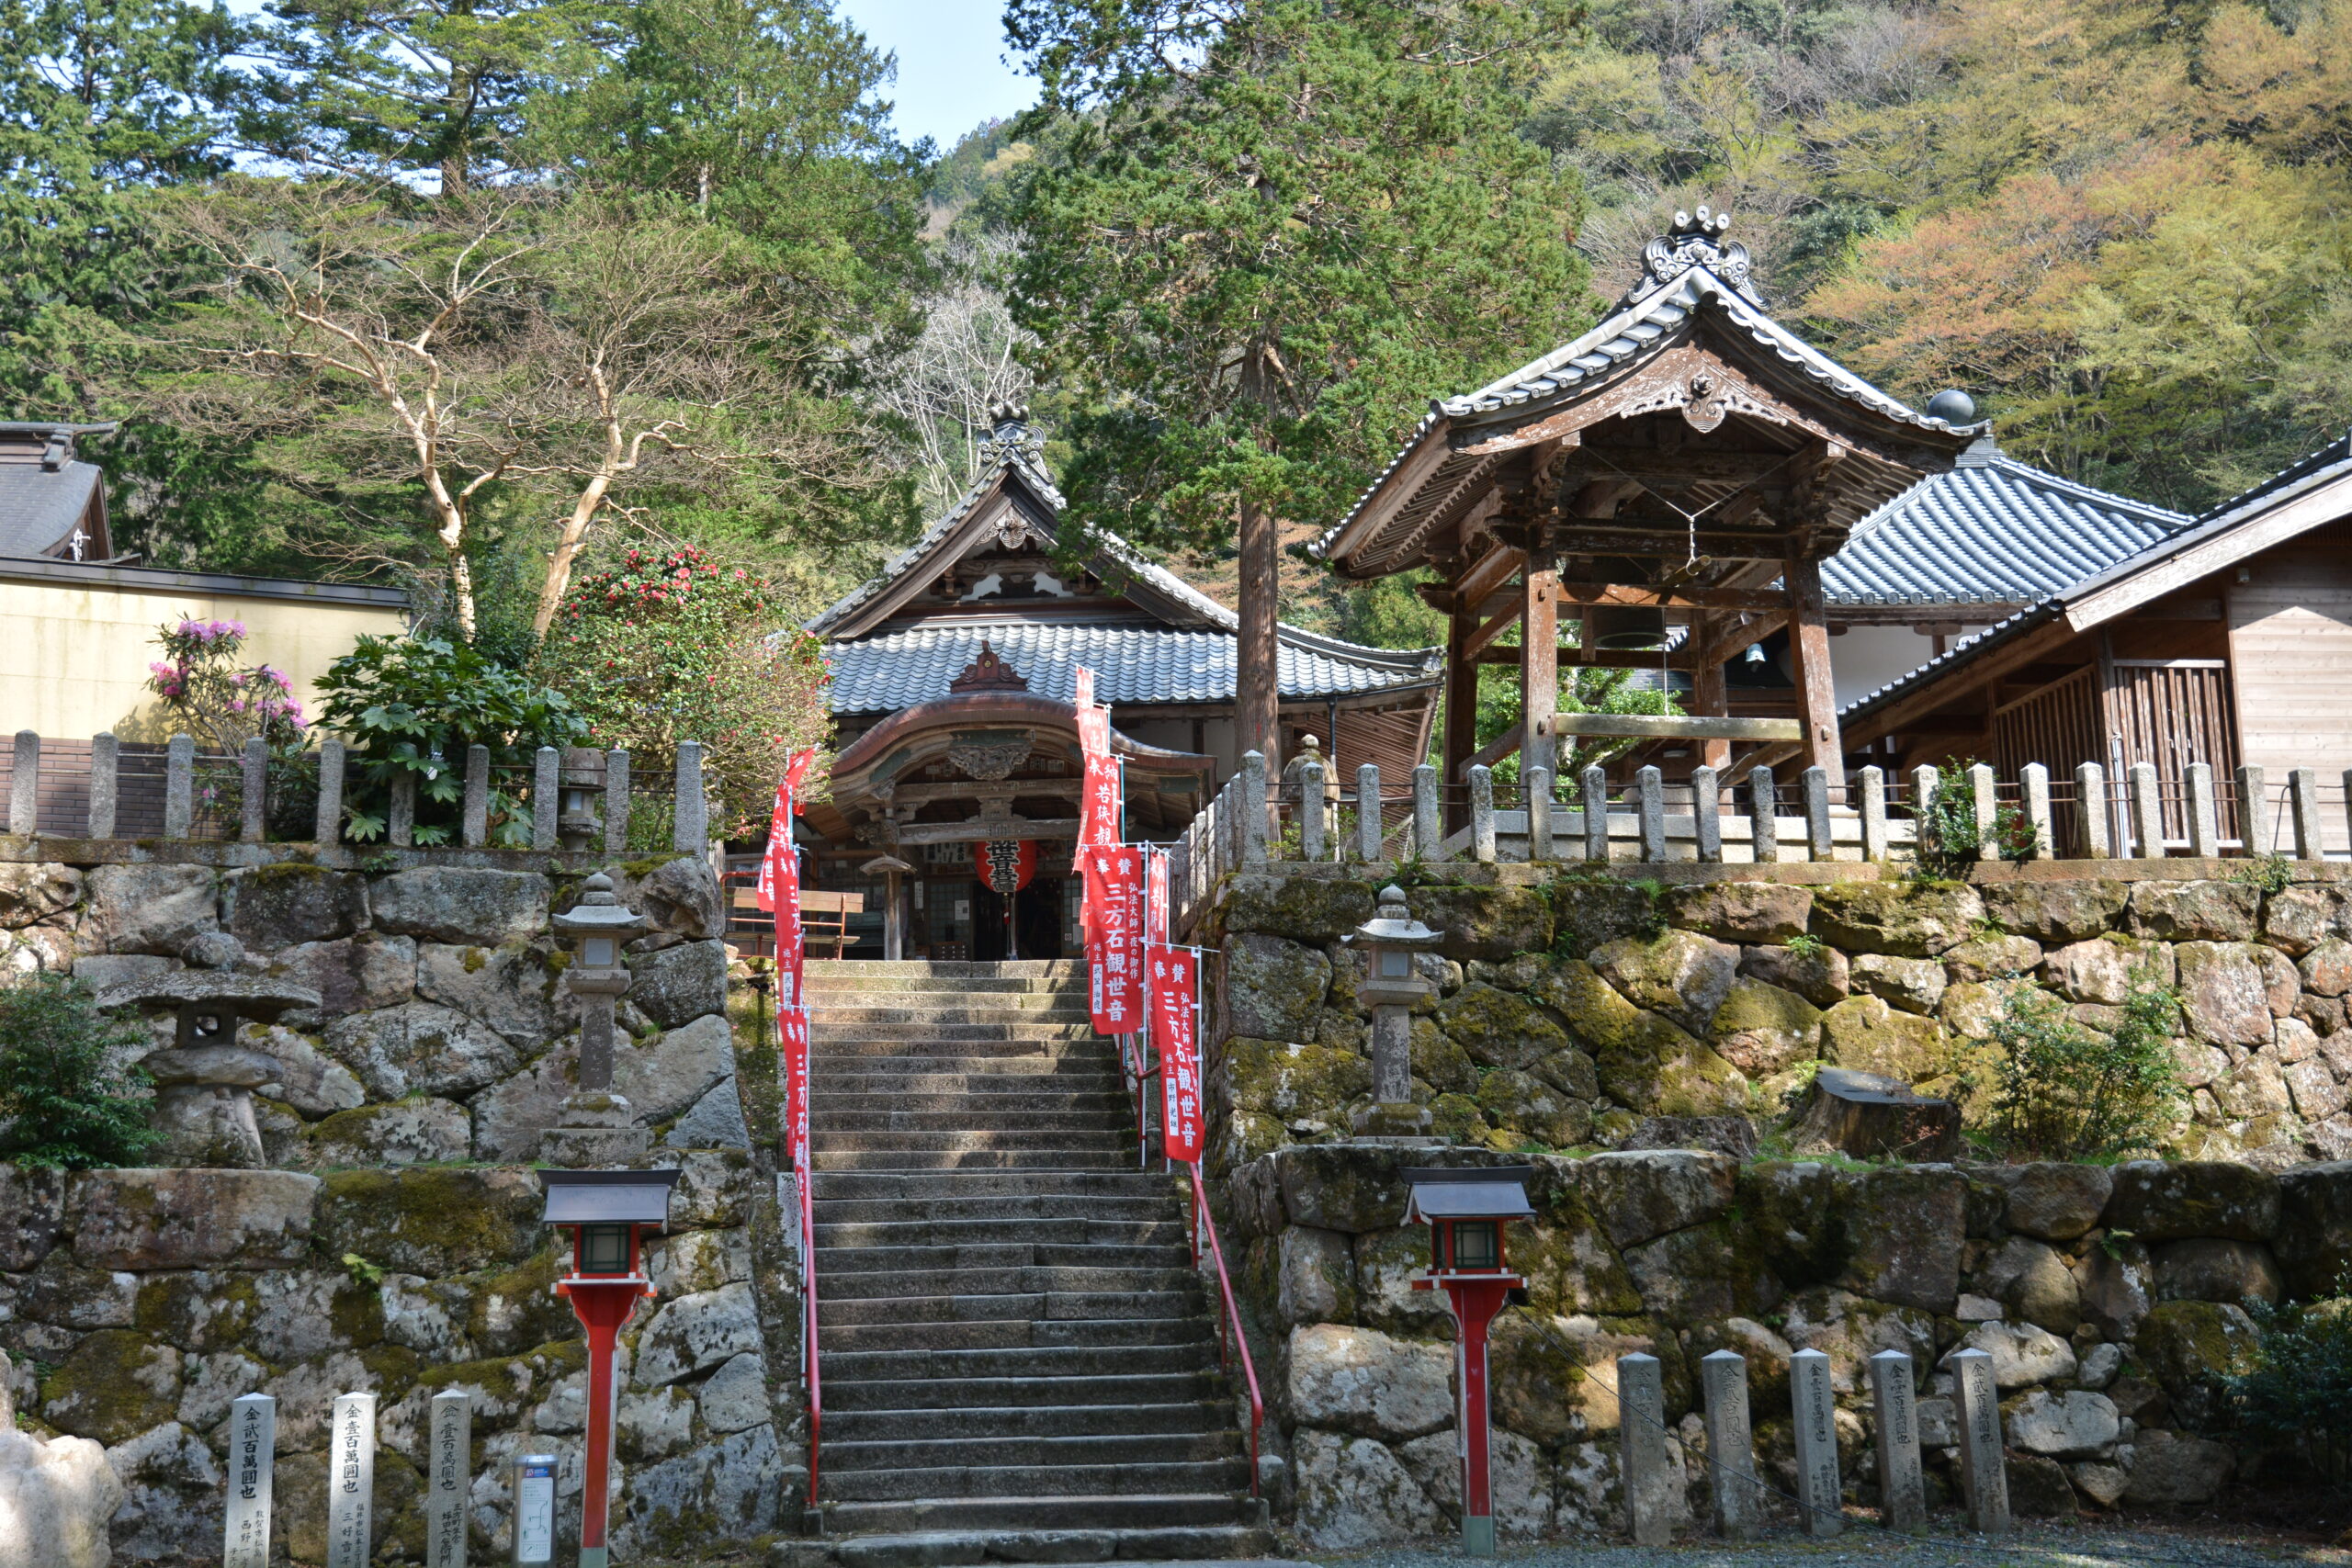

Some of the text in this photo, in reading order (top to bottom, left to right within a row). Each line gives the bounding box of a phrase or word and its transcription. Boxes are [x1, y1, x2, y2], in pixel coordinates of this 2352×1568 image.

[1088, 756, 1118, 783] 奉納
[1096, 858, 1132, 875] 奉賛
[1128, 882, 1139, 980] 弘法大師一夜の御作
[1093, 942, 1102, 962] 施主
[1104, 883, 1127, 1022] 三方石観世音
[1154, 960, 1186, 984] 奉賛
[1163, 991, 1196, 1148] 三方石観世音
[1165, 1053, 1174, 1075] 施主
